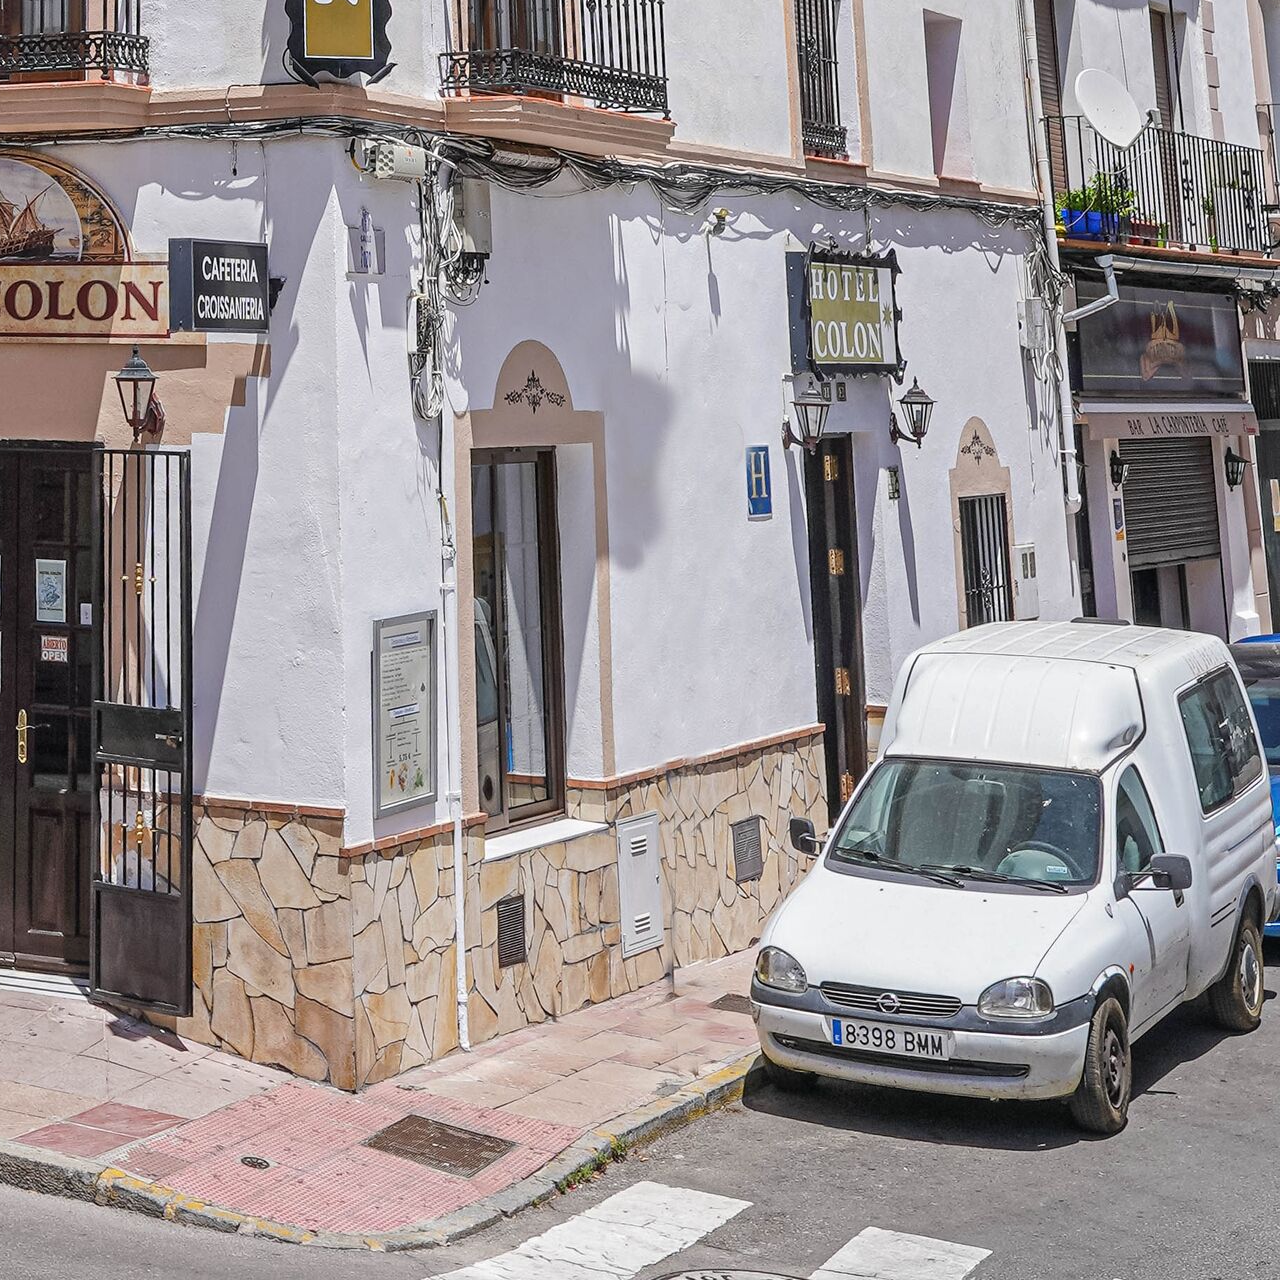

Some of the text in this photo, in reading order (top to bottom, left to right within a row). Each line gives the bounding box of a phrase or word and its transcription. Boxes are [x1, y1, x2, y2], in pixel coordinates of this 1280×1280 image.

[202, 256, 259, 283] CAFETERIA
[811, 268, 879, 303] HOTEL
[197, 294, 265, 321] CROISSANTERIA
[813, 320, 882, 359] COLON
[1127, 419, 1145, 436] BAR
[1148, 416, 1163, 435] LA
[750, 451, 769, 499] H
[41, 650, 68, 662] OPEN
[42, 638, 68, 651] ABIERTO
[845, 1023, 897, 1050] 8398
[903, 1030, 944, 1057] BMM
